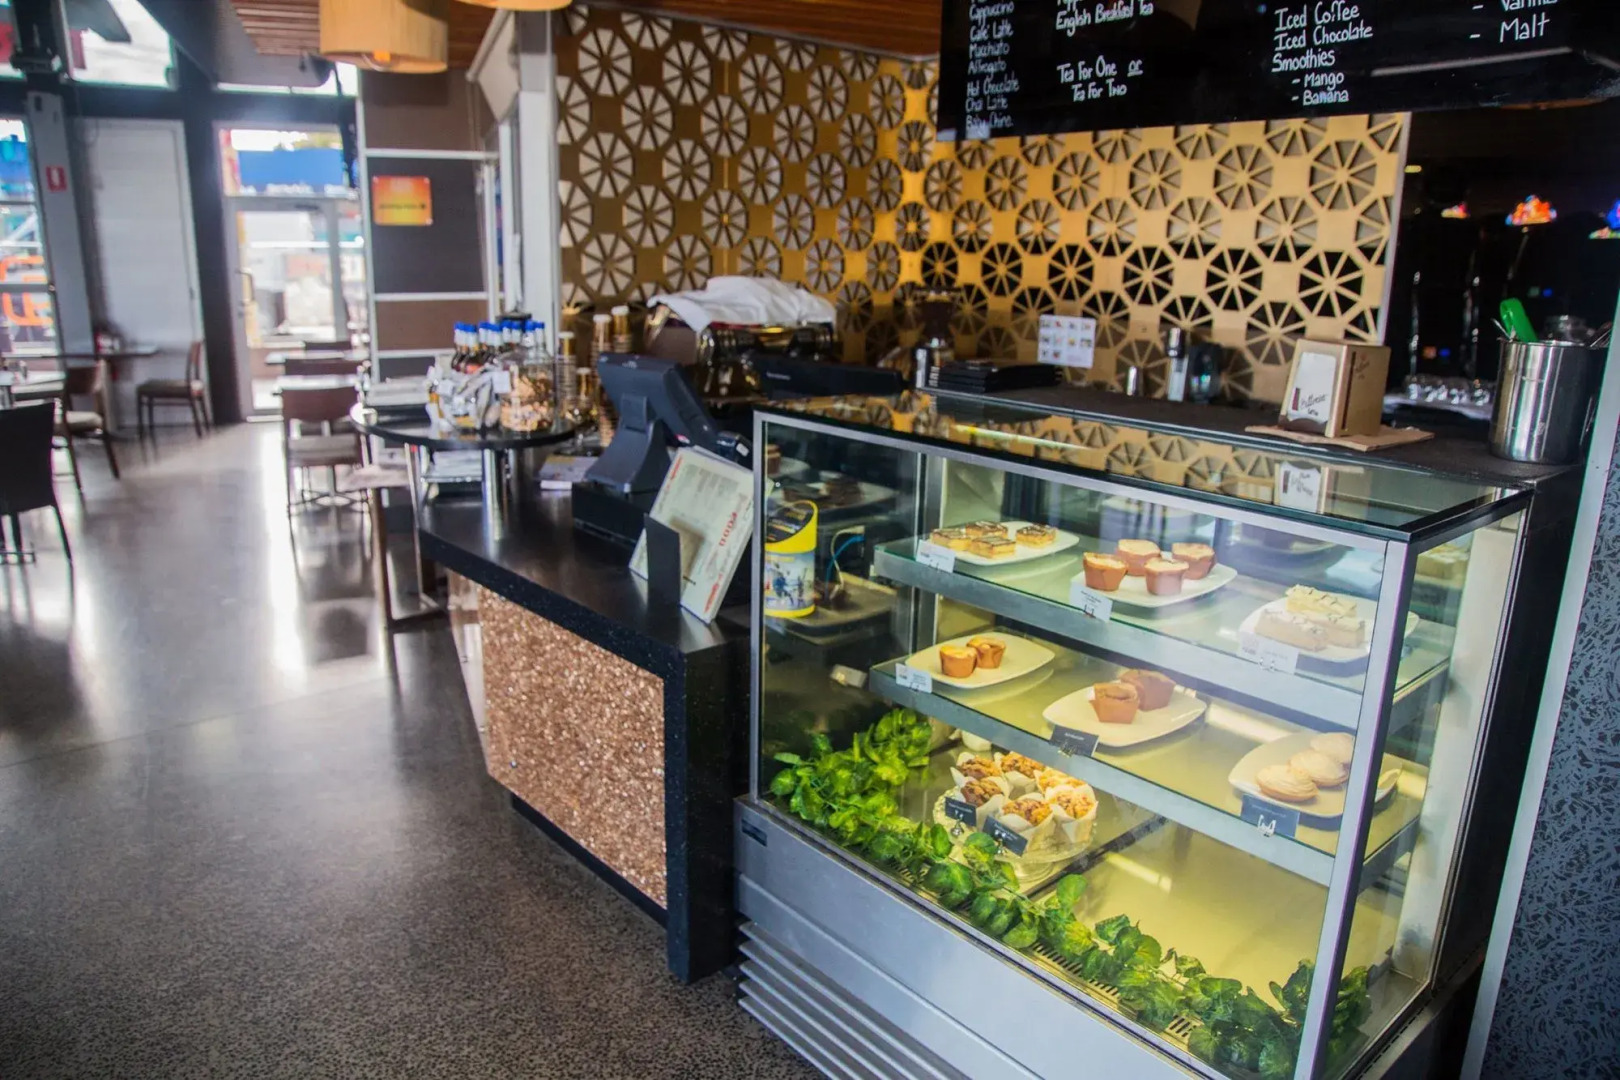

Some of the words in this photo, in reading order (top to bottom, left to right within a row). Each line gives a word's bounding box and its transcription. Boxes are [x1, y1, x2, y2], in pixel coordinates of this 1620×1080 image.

[1274, 4, 1307, 32] Iced
[1314, 0, 1360, 25] Coffee
[1501, 0, 1558, 11] Vani
[992, 18, 1014, 39] Latte
[1056, 8, 1091, 37] English
[1094, 0, 1134, 24] Breakfast
[1138, 0, 1154, 15] Tea
[1499, 12, 1550, 43] Malt
[1273, 29, 1307, 52] Iced
[1313, 19, 1374, 46] Chocolate
[1056, 63, 1074, 83] Tea
[1078, 60, 1093, 81] For
[1096, 55, 1117, 77] One
[1128, 59, 1143, 76] or
[1271, 48, 1336, 73] Smoothies
[1071, 83, 1085, 102] Tea
[1088, 81, 1103, 99] For
[1106, 78, 1127, 97] Two
[1304, 72, 1345, 91] Mango
[987, 95, 1008, 110] Latte
[1302, 89, 1349, 106] Banana
